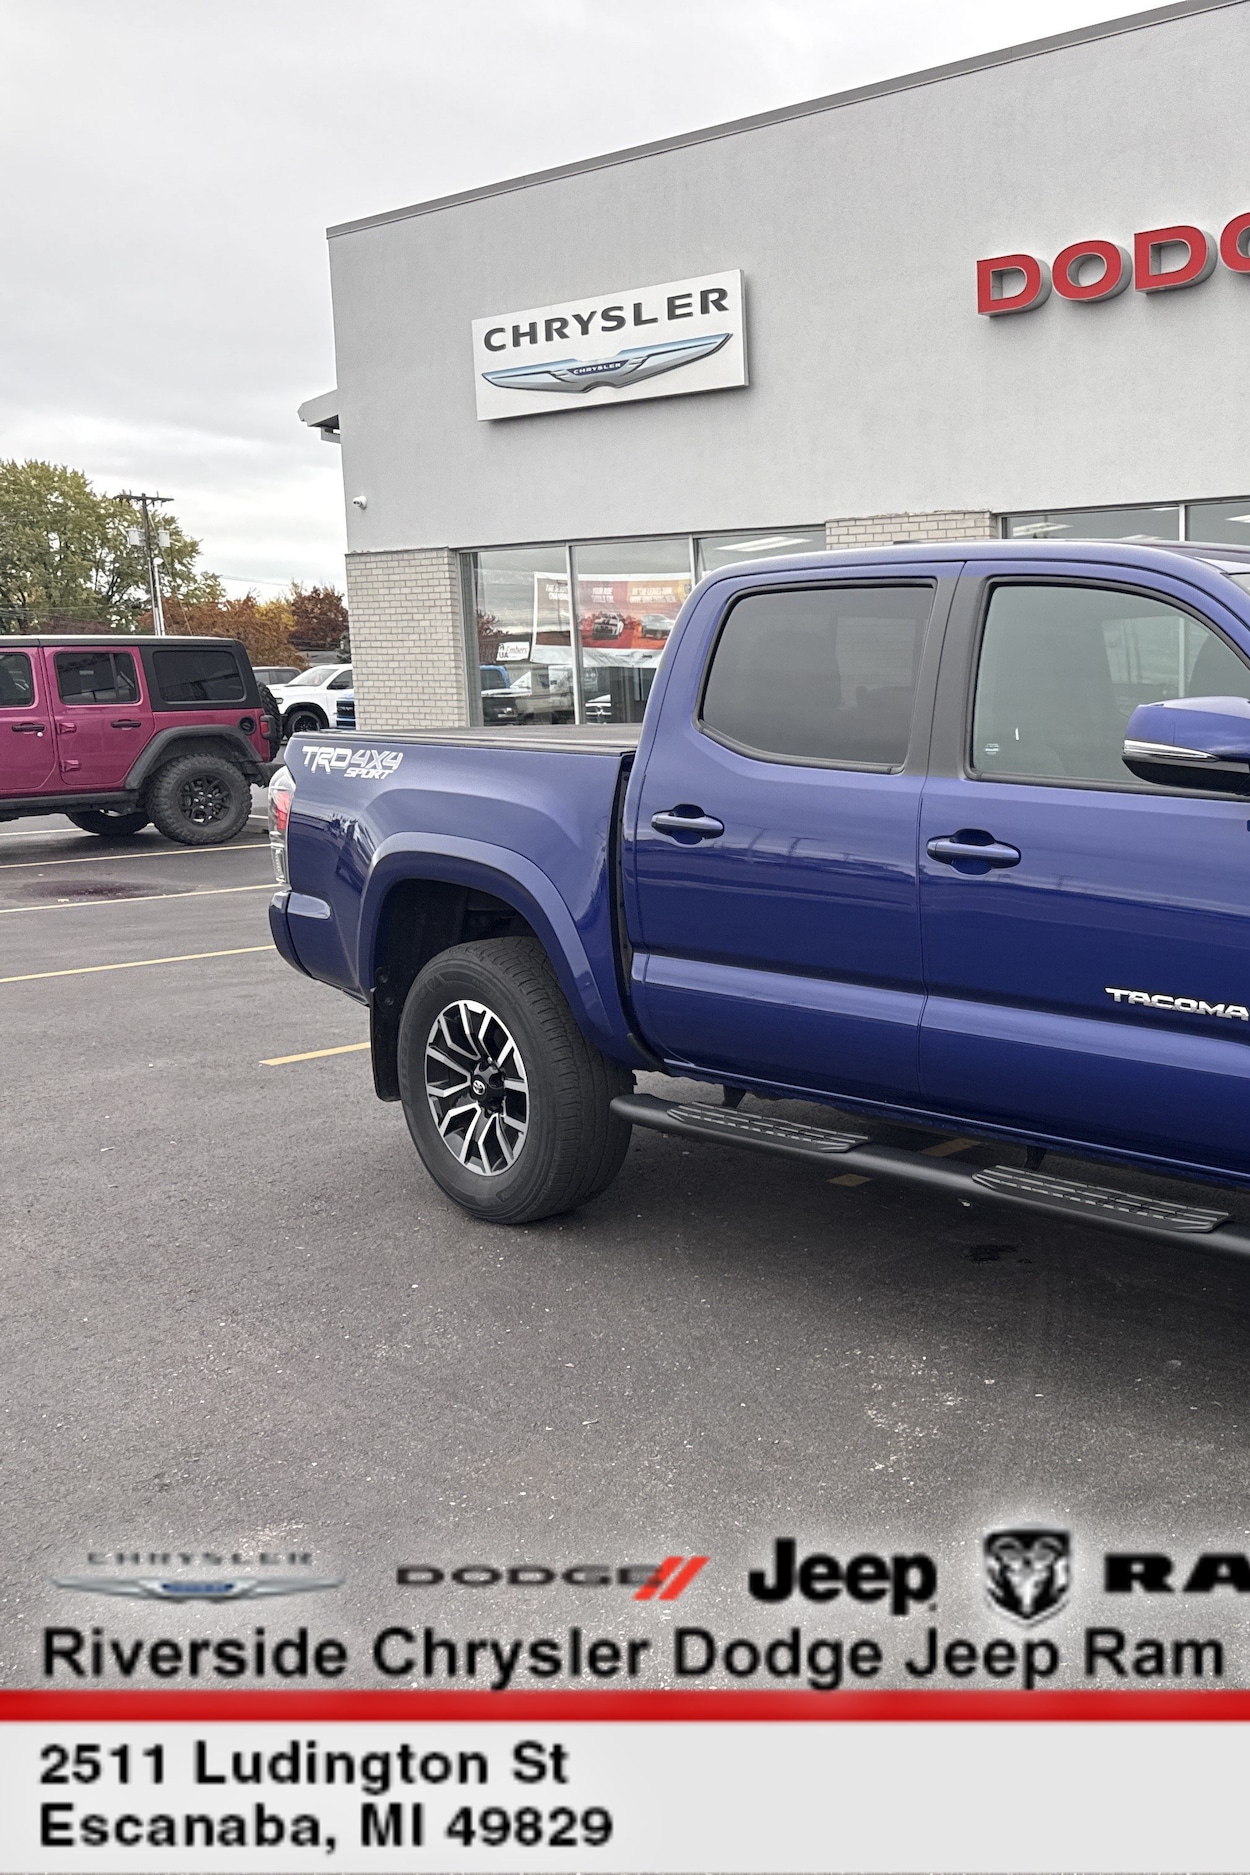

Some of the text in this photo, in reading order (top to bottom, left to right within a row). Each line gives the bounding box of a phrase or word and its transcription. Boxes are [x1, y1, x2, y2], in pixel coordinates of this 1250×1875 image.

[483, 287, 730, 352] CHRYSLER
[573, 362, 621, 375] CHRYSLER
[302, 746, 352, 774] TRD
[344, 767, 394, 780] SPORT
[1104, 987, 1250, 1021] TACOMA
